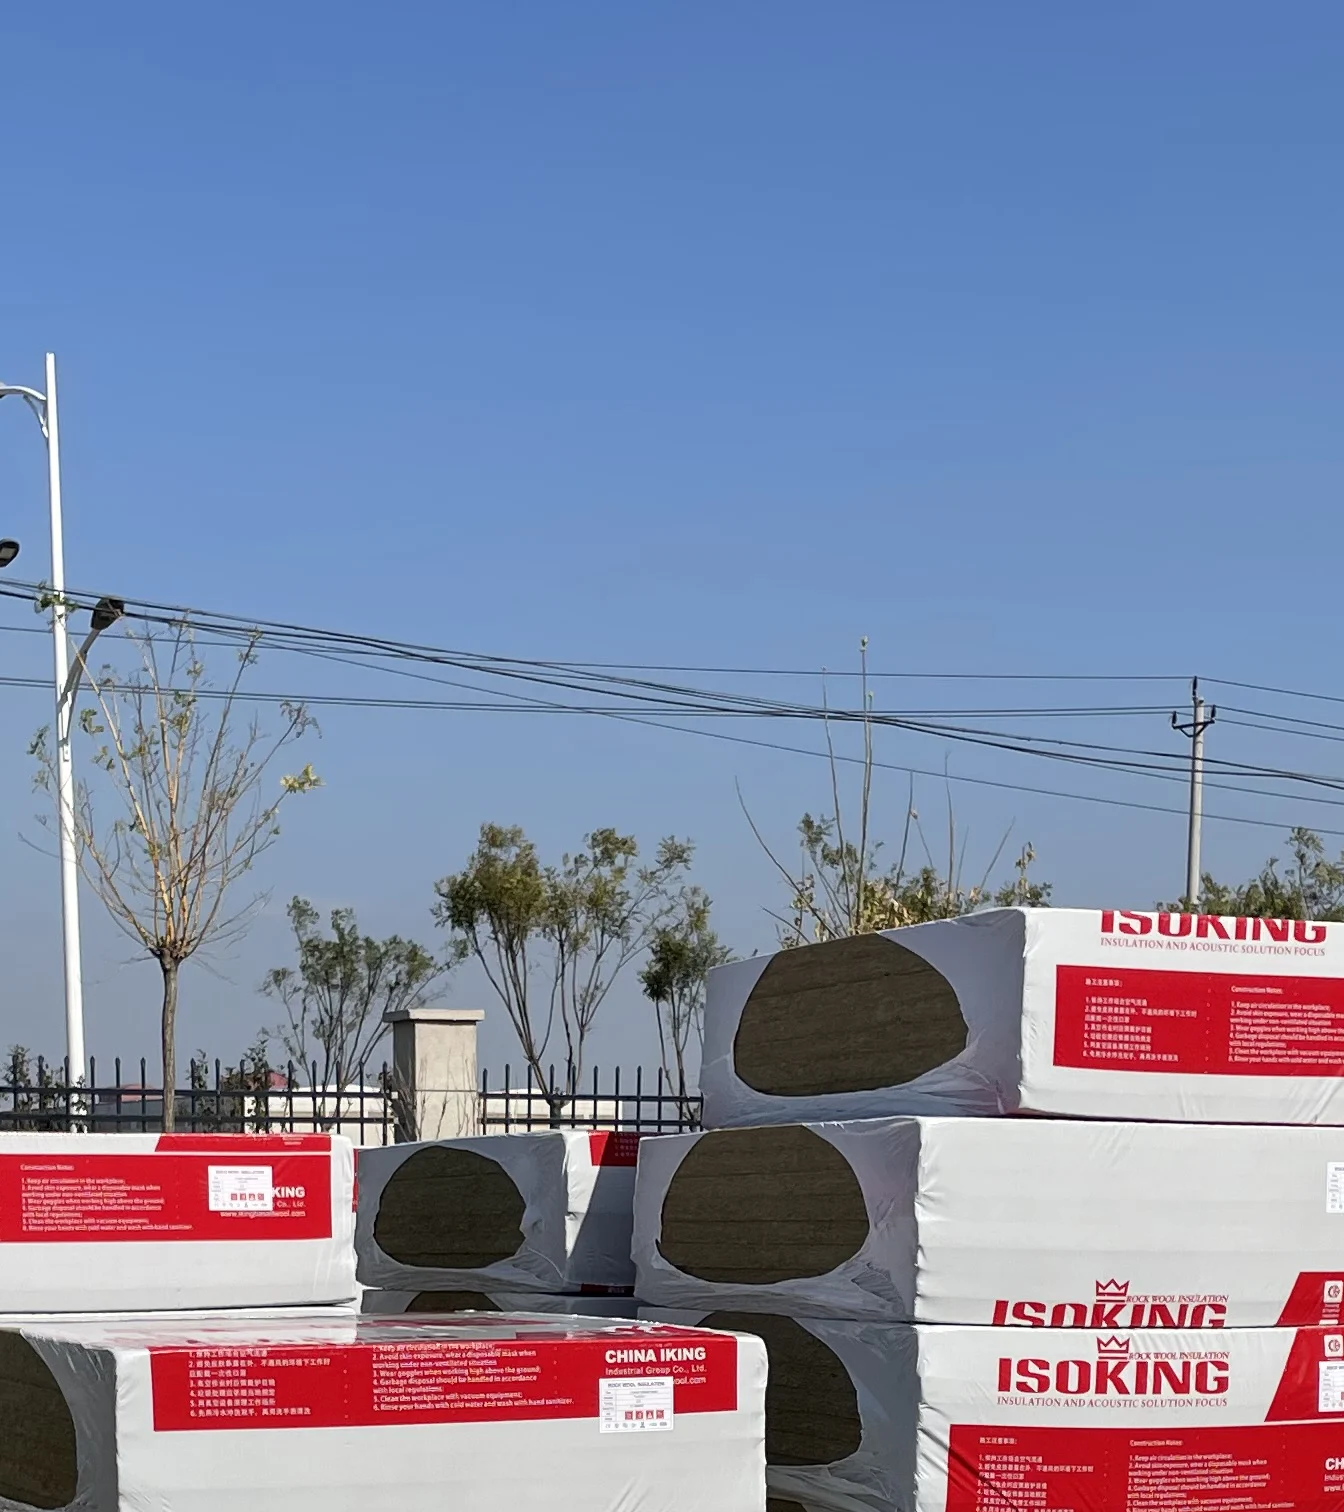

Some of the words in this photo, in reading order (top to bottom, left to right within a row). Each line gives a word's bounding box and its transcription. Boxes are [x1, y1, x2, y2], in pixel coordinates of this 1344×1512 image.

[1100, 937, 1163, 948] INSULATION
[1165, 941, 1187, 950] AND
[1189, 942, 1238, 953] ACOUSTIC
[1241, 945, 1291, 954] SOLUTION
[1294, 946, 1325, 956] FOCUS
[272, 1186, 305, 1198] KING
[1126, 1294, 1149, 1303] ROCK
[1151, 1295, 1175, 1303] WOOL
[1178, 1294, 1228, 1303] INSULATION
[992, 1300, 1227, 1329] ISOKING
[605, 1349, 656, 1363] CHINA
[660, 1347, 706, 1361] IKING
[605, 1366, 643, 1375] Industrial
[645, 1366, 671, 1375] Group
[998, 1358, 1229, 1395] ISOKING
[997, 1396, 1060, 1406] INSULATION
[1063, 1398, 1086, 1407] AND
[1087, 1399, 1137, 1408] ACOUSTIC
[1141, 1398, 1193, 1408] SOLUTION
[1195, 1398, 1227, 1407] FOCUS
